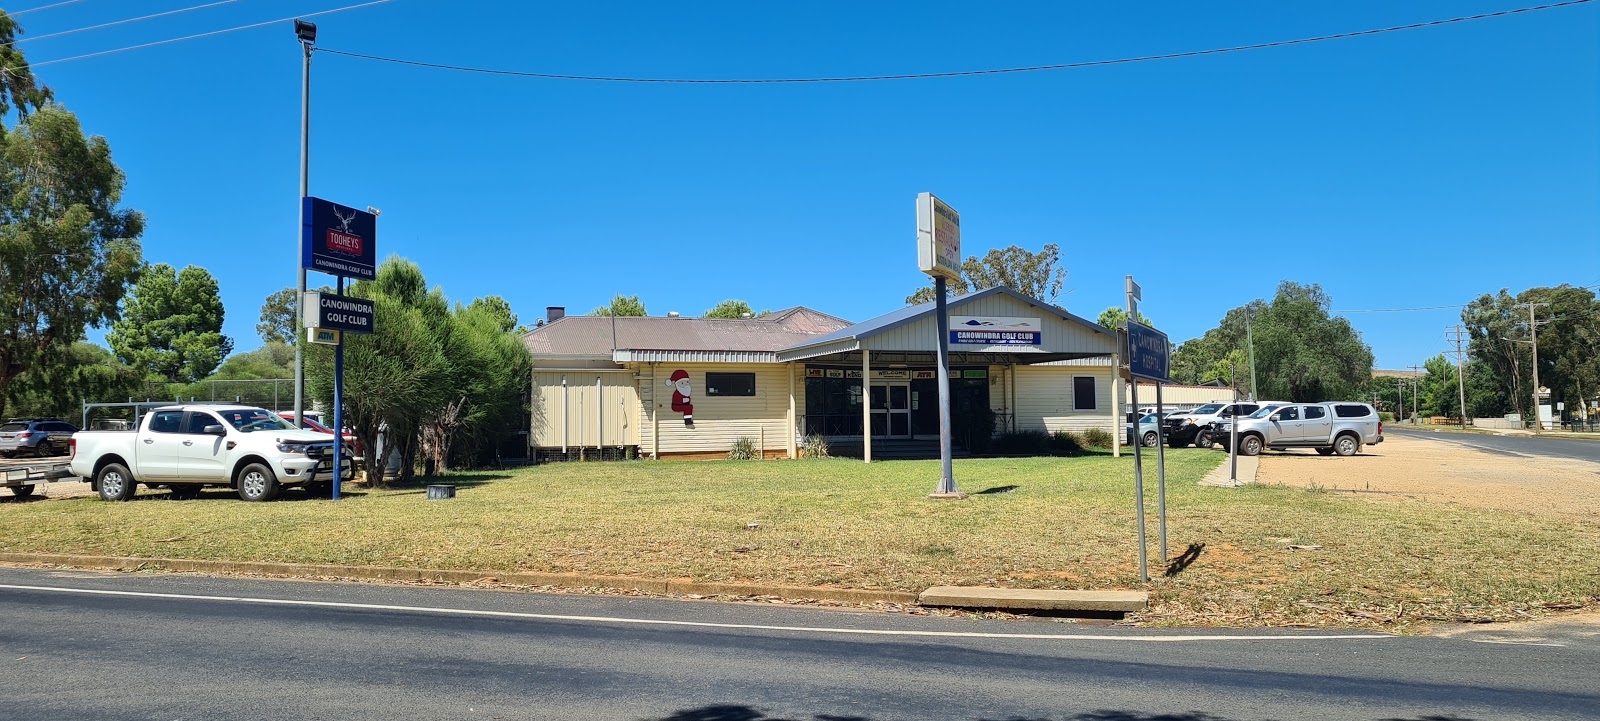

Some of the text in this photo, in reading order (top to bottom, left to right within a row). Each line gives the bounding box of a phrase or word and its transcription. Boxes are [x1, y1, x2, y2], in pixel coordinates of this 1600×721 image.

[330, 232, 359, 249] TOOHEYS
[315, 258, 373, 276] CANOWINDRA GOLF CLUB
[320, 298, 373, 314] CANOWINDRA
[327, 312, 367, 326] GOLF CLUB
[317, 331, 335, 341] ATM
[957, 331, 1000, 339] CANOWINDRA
[1001, 332, 1017, 340] GOLF
[1142, 354, 1162, 372] HOSPITAL
